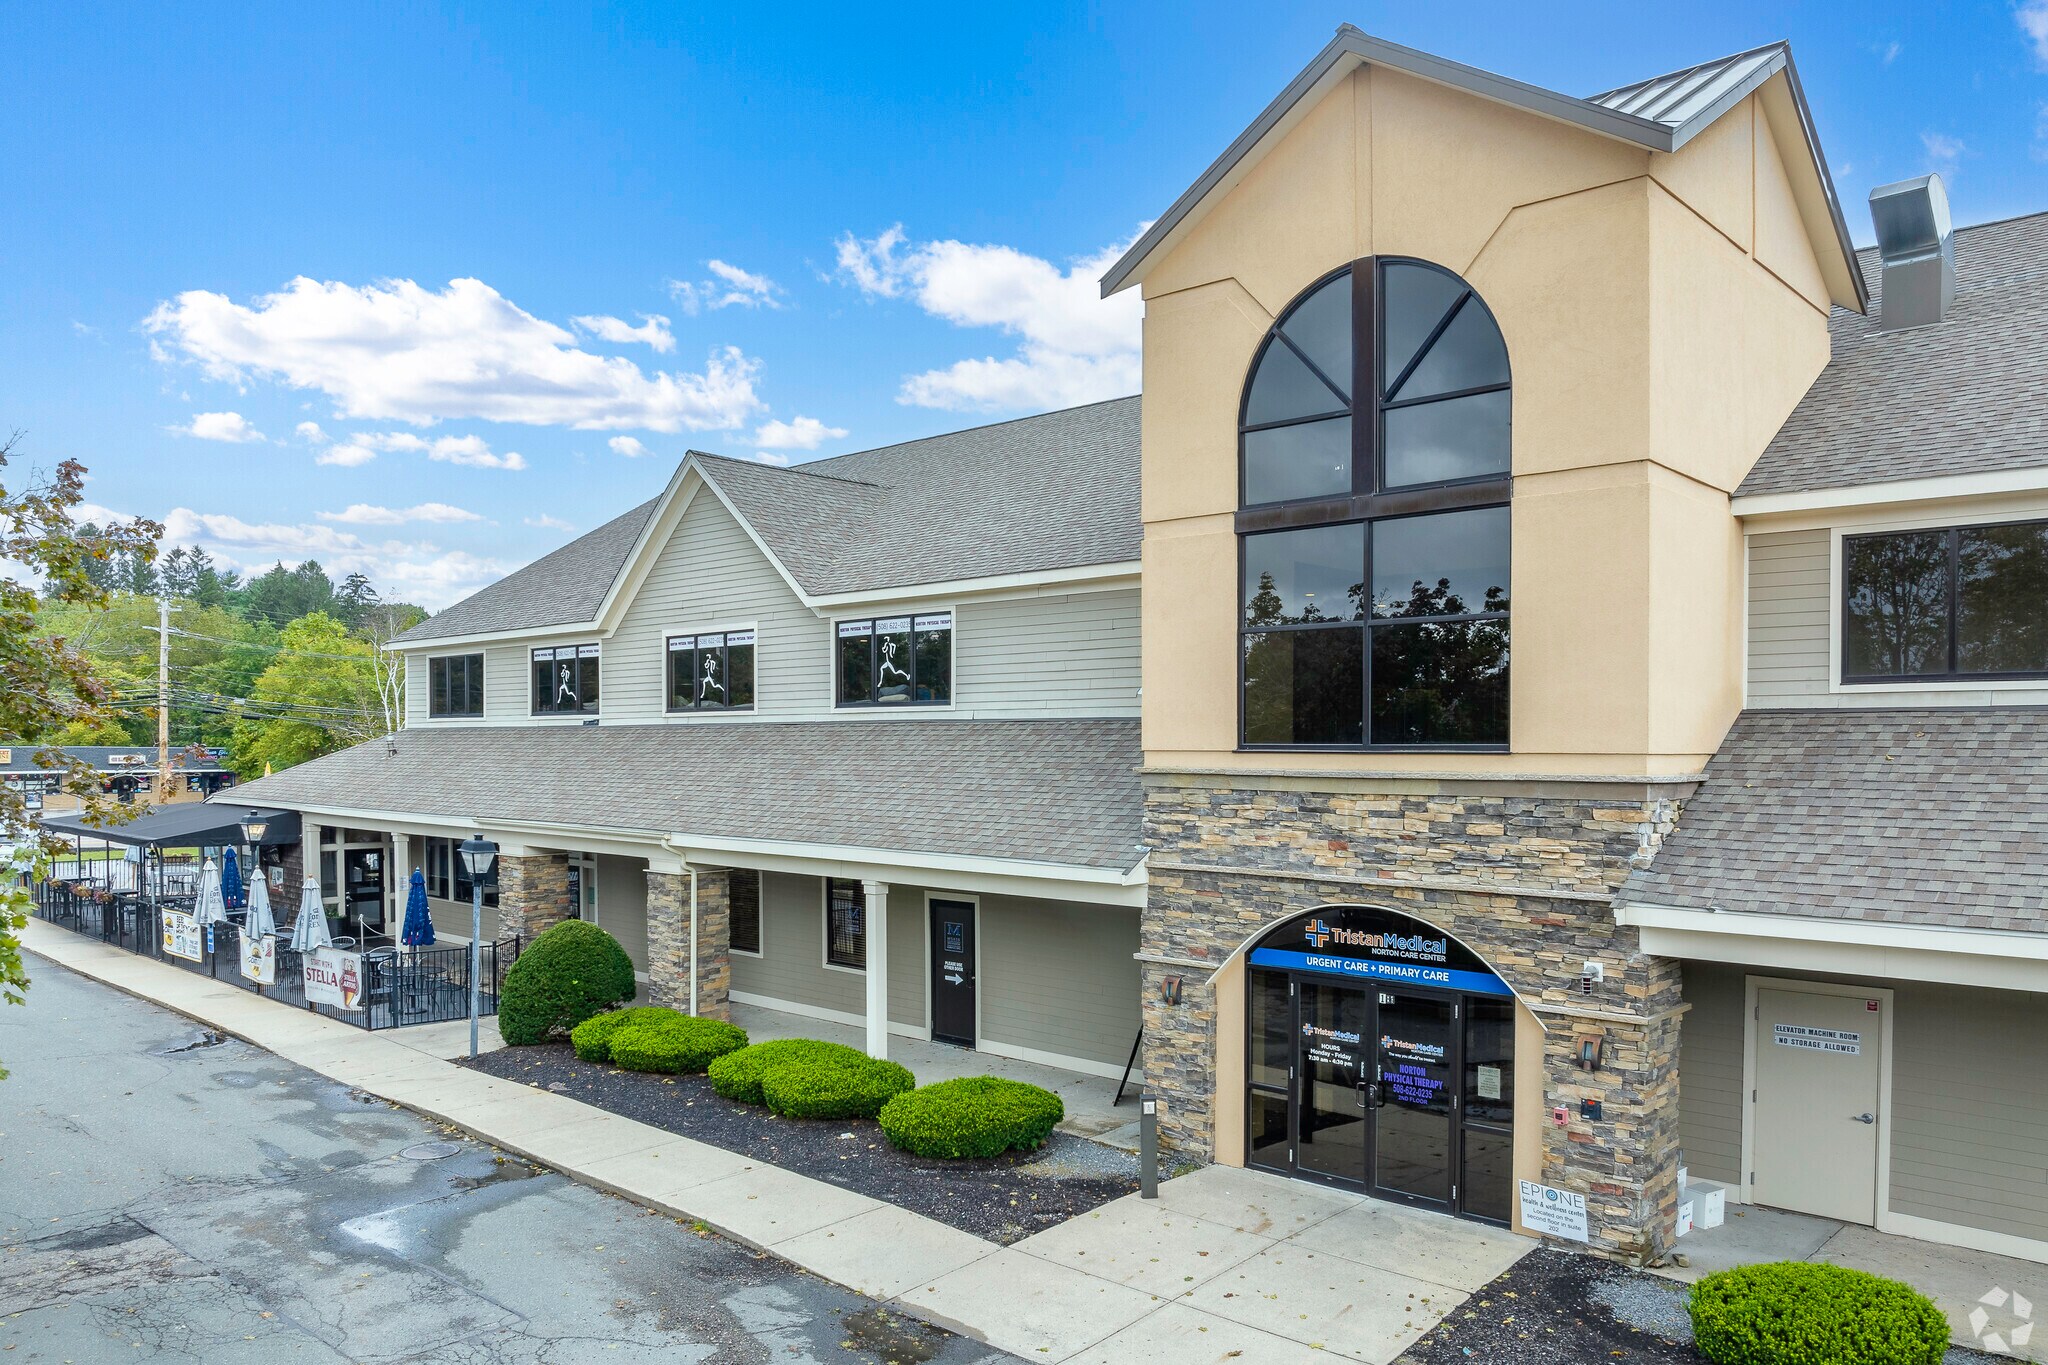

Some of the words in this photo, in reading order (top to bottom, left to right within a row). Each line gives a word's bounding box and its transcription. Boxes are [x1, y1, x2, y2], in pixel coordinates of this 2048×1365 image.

[1331, 928, 1446, 954] TristanMedical
[1371, 947, 1400, 957] NORTON
[1400, 951, 1419, 960] CARE
[1419, 954, 1447, 962] CENTER
[306, 967, 338, 987] STELLA
[1306, 956, 1342, 969] URGENT
[1343, 960, 1369, 972] CARE
[1378, 964, 1421, 979] PRIMARY
[1422, 970, 1450, 982] CARE
[1313, 1027, 1360, 1041] TristanMedical
[1776, 1025, 1806, 1034] ELEVATOR
[1808, 1029, 1837, 1038] MACHINE
[1839, 1033, 1858, 1041] ROOM
[1321, 1043, 1341, 1052] HOURS
[1392, 1039, 1444, 1054] TristanMedical
[1791, 1039, 1821, 1048] STORAGE
[1824, 1043, 1855, 1052] ALLOWED
[1310, 1048, 1330, 1057] Monday
[1334, 1052, 1352, 1061] Friday
[1399, 1064, 1426, 1077] NORTON
[1384, 1071, 1414, 1086] PHYSICAL
[1414, 1076, 1444, 1090] THERAPY
[1392, 1083, 1433, 1099] 508-622-0235
[1409, 1097, 1428, 1105] FLOOR
[1520, 1181, 1583, 1209] EPIONE
[1522, 1196, 1539, 1207] health
[1545, 1204, 1567, 1214] wellness
[1568, 1209, 1585, 1218] center
[1532, 1207, 1555, 1219] Located
[1564, 1215, 1574, 1223] the
[1526, 1212, 1547, 1223] second
[1547, 1217, 1561, 1227] floor
[1567, 1222, 1582, 1231] suite
[1548, 1224, 1560, 1233] 202
